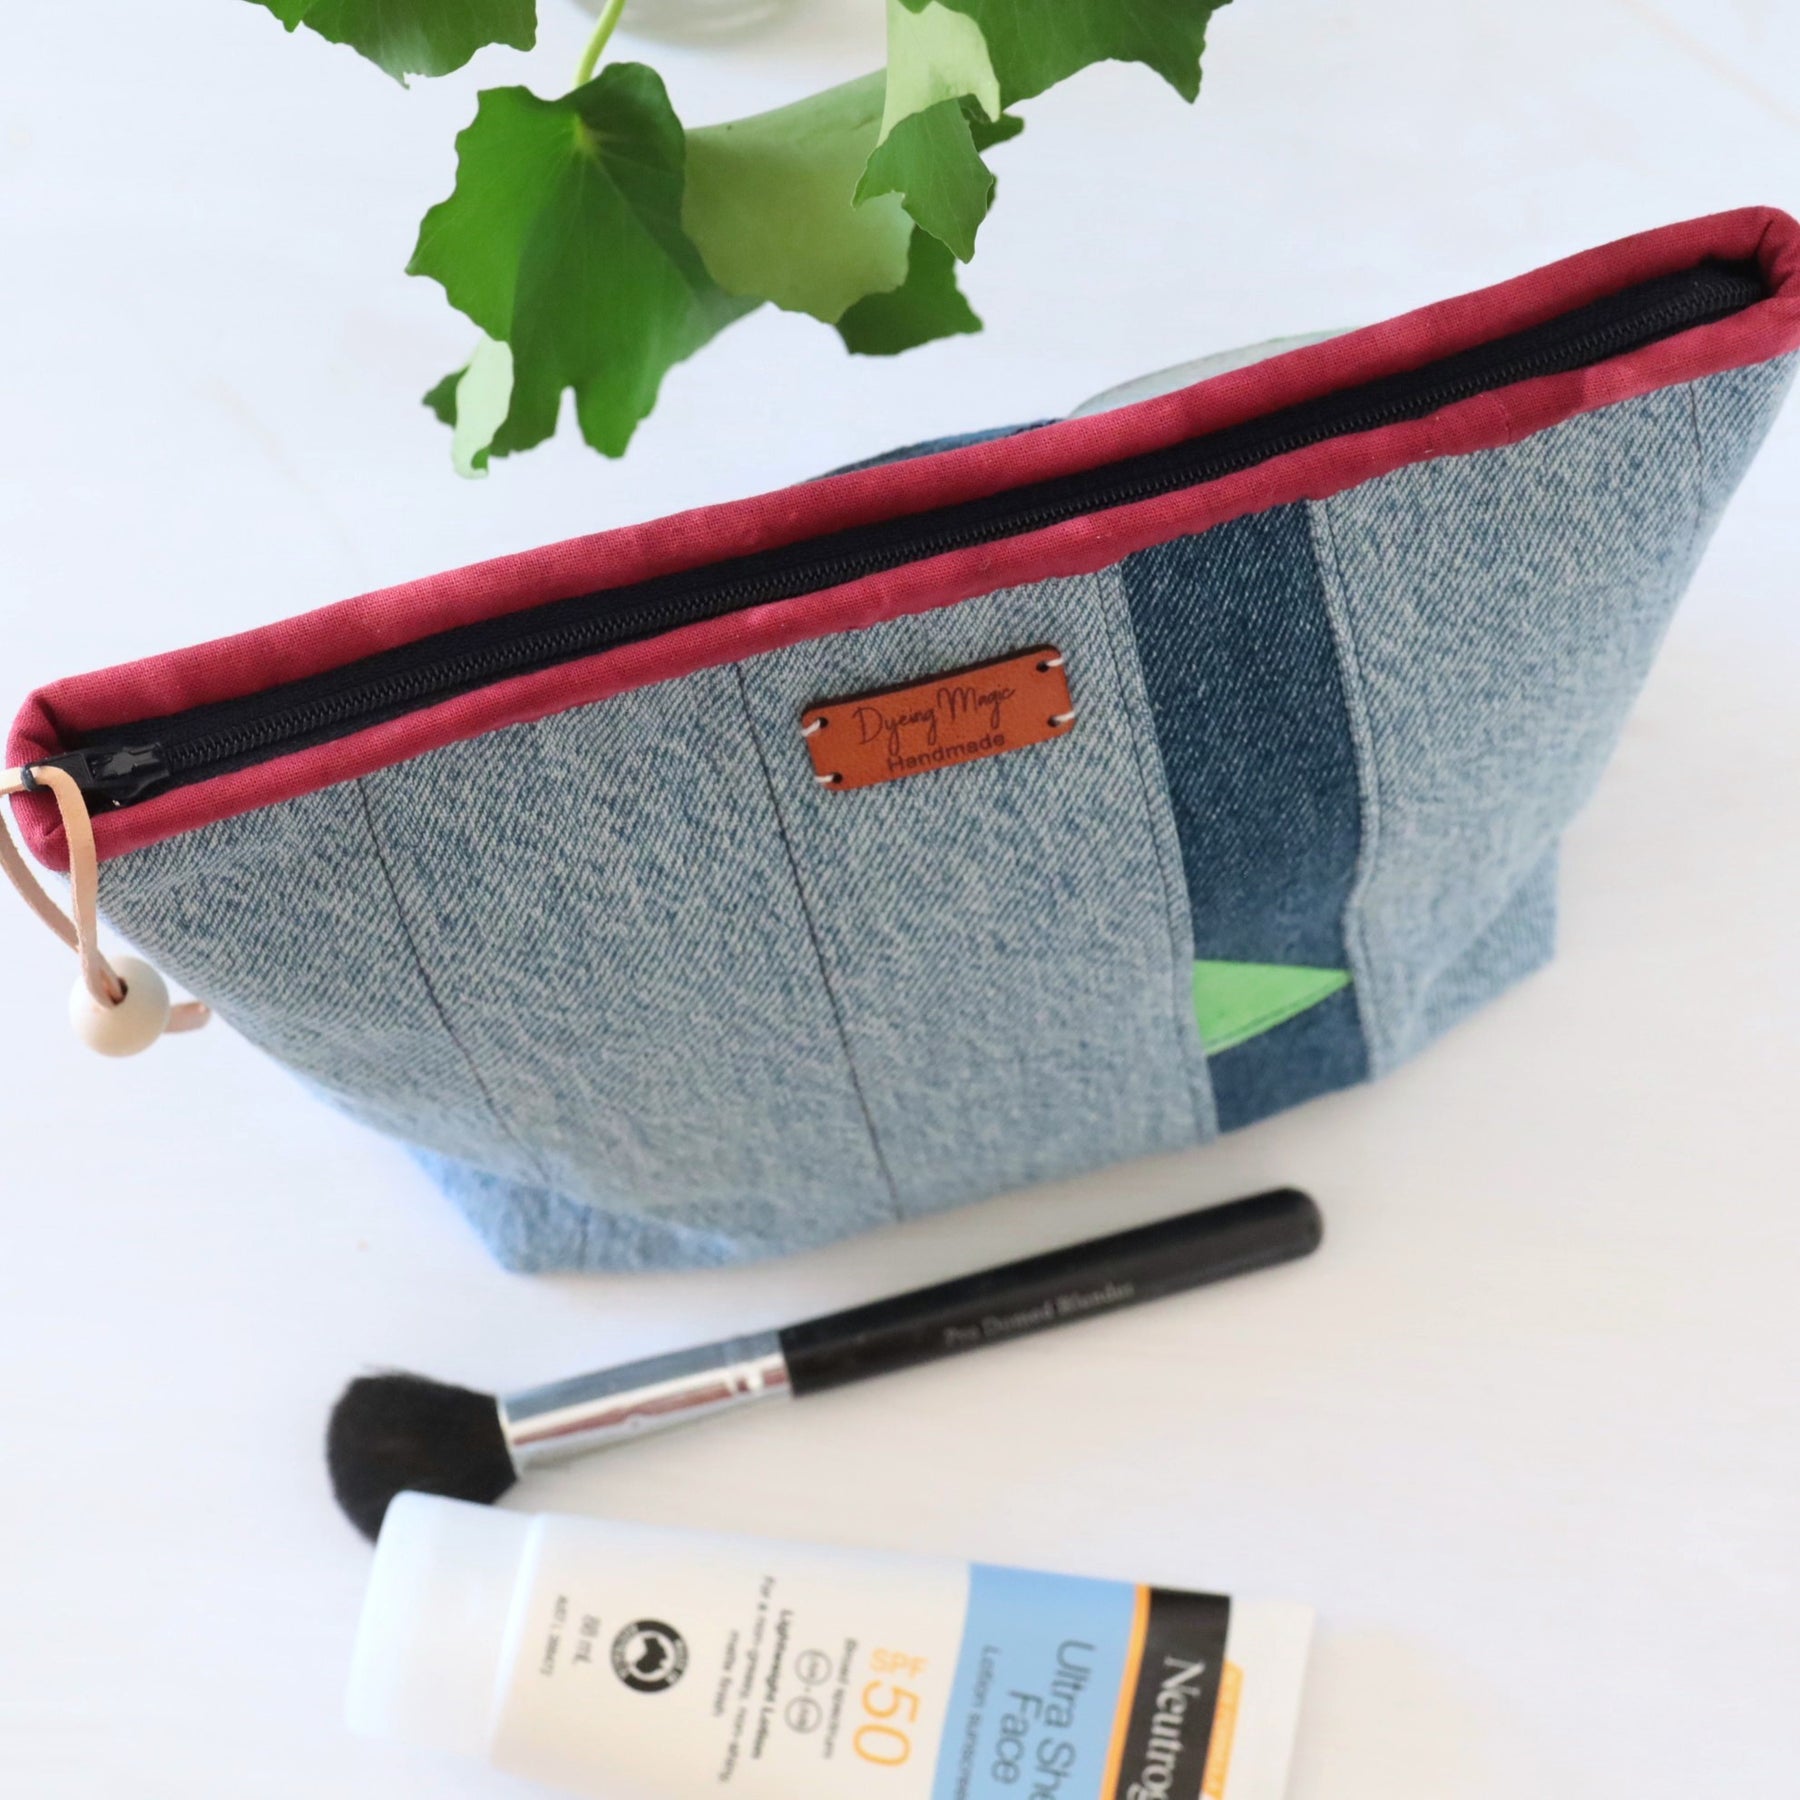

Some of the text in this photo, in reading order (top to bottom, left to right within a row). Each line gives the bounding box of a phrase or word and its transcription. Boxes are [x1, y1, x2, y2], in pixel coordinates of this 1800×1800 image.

[852, 685, 1016, 756] Dyeing Magic
[886, 732, 1006, 772] Handmade
[751, 1608, 795, 1760] Lightweight Lotion
[852, 1647, 928, 1766] SPF 50
[972, 1644, 1002, 1709] Lotion
[1043, 1639, 1097, 1729] Ultra
[990, 1688, 1044, 1785] Face
